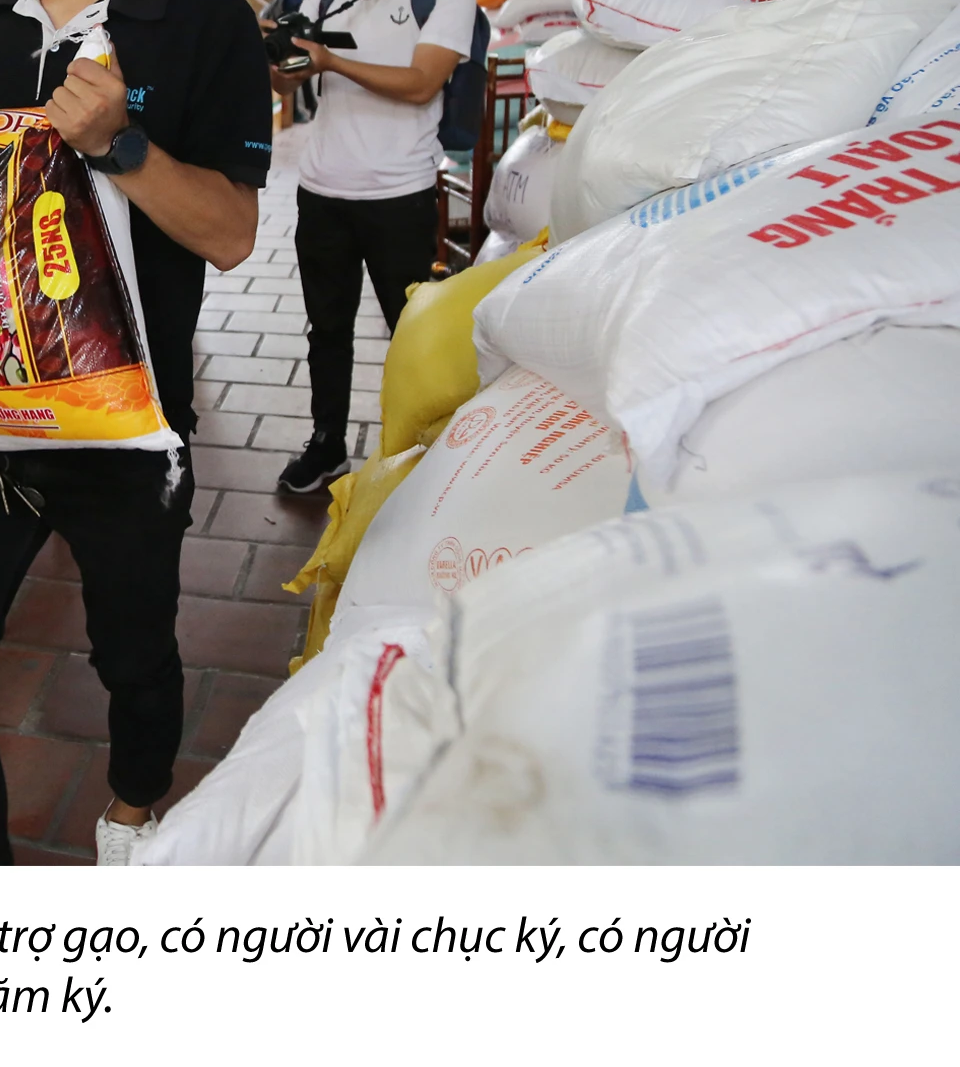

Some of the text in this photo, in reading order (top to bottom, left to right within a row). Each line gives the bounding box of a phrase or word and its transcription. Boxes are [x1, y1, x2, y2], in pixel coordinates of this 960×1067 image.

[747, 166, 960, 250] TRẮNG
[40, 208, 72, 278] 25KG
[22, 407, 56, 423] HẠNG
[535, 408, 569, 433] NAM
[519, 429, 565, 466] NGHIỆP
